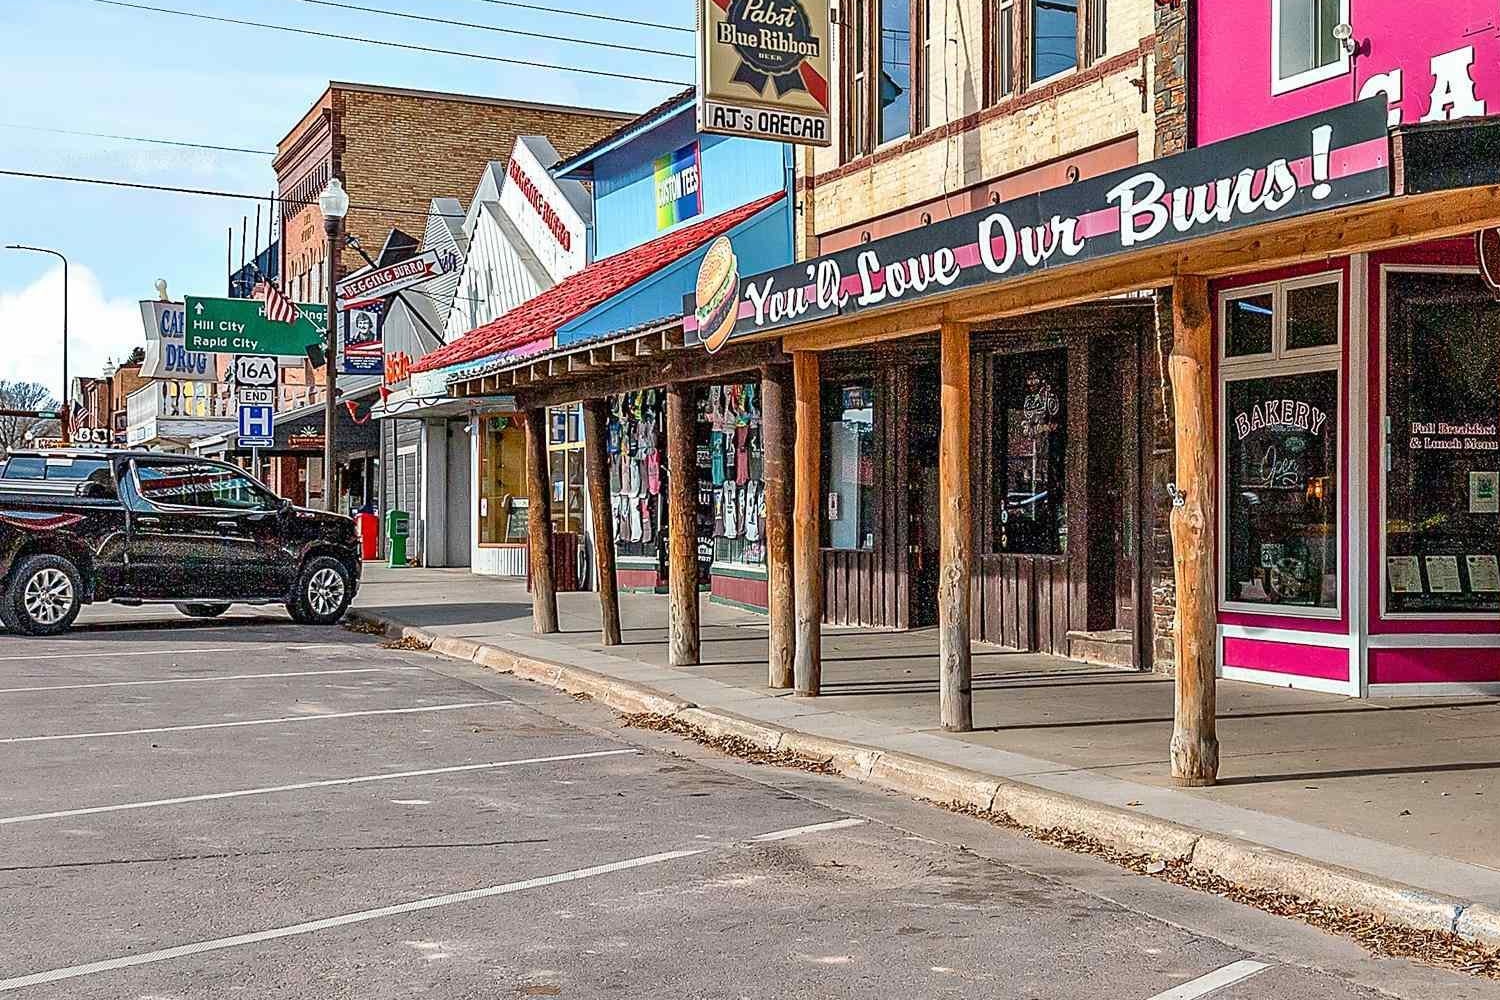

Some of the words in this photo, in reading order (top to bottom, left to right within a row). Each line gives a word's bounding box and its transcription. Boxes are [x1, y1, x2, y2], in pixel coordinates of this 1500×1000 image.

[718, 23, 758, 47] Blue
[759, 29, 819, 57] Ribbon
[758, 52, 783, 62] BEER
[713, 107, 753, 130] AJ's
[758, 112, 825, 139] ORECAR
[682, 165, 698, 197] TEES
[744, 260, 848, 326] You'll
[856, 245, 960, 306] Love
[976, 212, 1085, 275] Our
[1106, 124, 1334, 247] Buns!
[344, 270, 393, 297] BEGGING
[392, 260, 424, 279] BURRO
[193, 320, 214, 330] Hill
[219, 321, 246, 334] City
[193, 335, 228, 348] Rapid
[232, 337, 259, 350] City
[165, 343, 208, 373] DRUG
[240, 361, 272, 379] 16A
[245, 391, 267, 401] END
[1234, 399, 1327, 440] BAKERY
[1411, 422, 1436, 434] Full
[1438, 422, 1497, 435] Breakfast
[1409, 437, 1422, 449] &
[1424, 437, 1462, 449] Lunch
[1464, 437, 1499, 450] Menu
